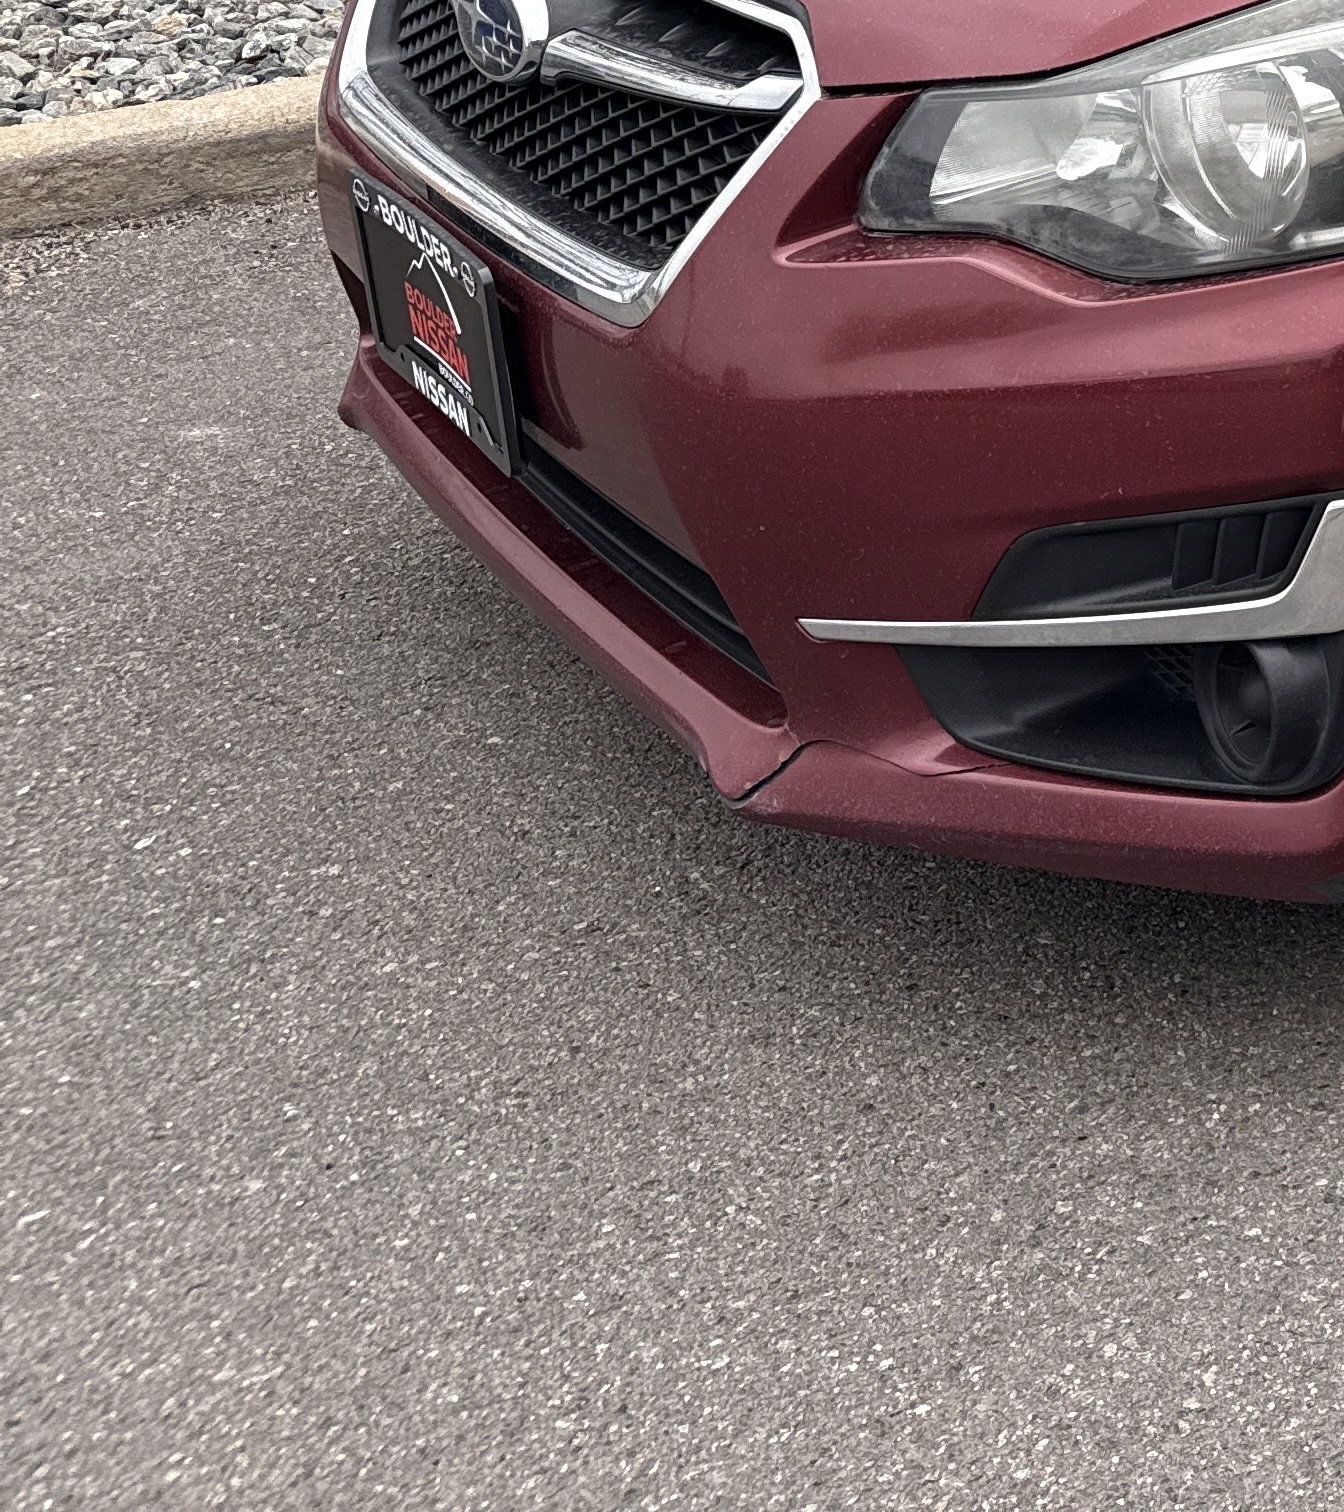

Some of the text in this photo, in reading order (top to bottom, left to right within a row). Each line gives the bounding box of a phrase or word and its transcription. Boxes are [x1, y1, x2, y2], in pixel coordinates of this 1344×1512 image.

[377, 194, 455, 278] BOULDER
[404, 281, 458, 343] BOULDER
[408, 304, 471, 386] NISSAN
[411, 360, 471, 437] NISSAN
